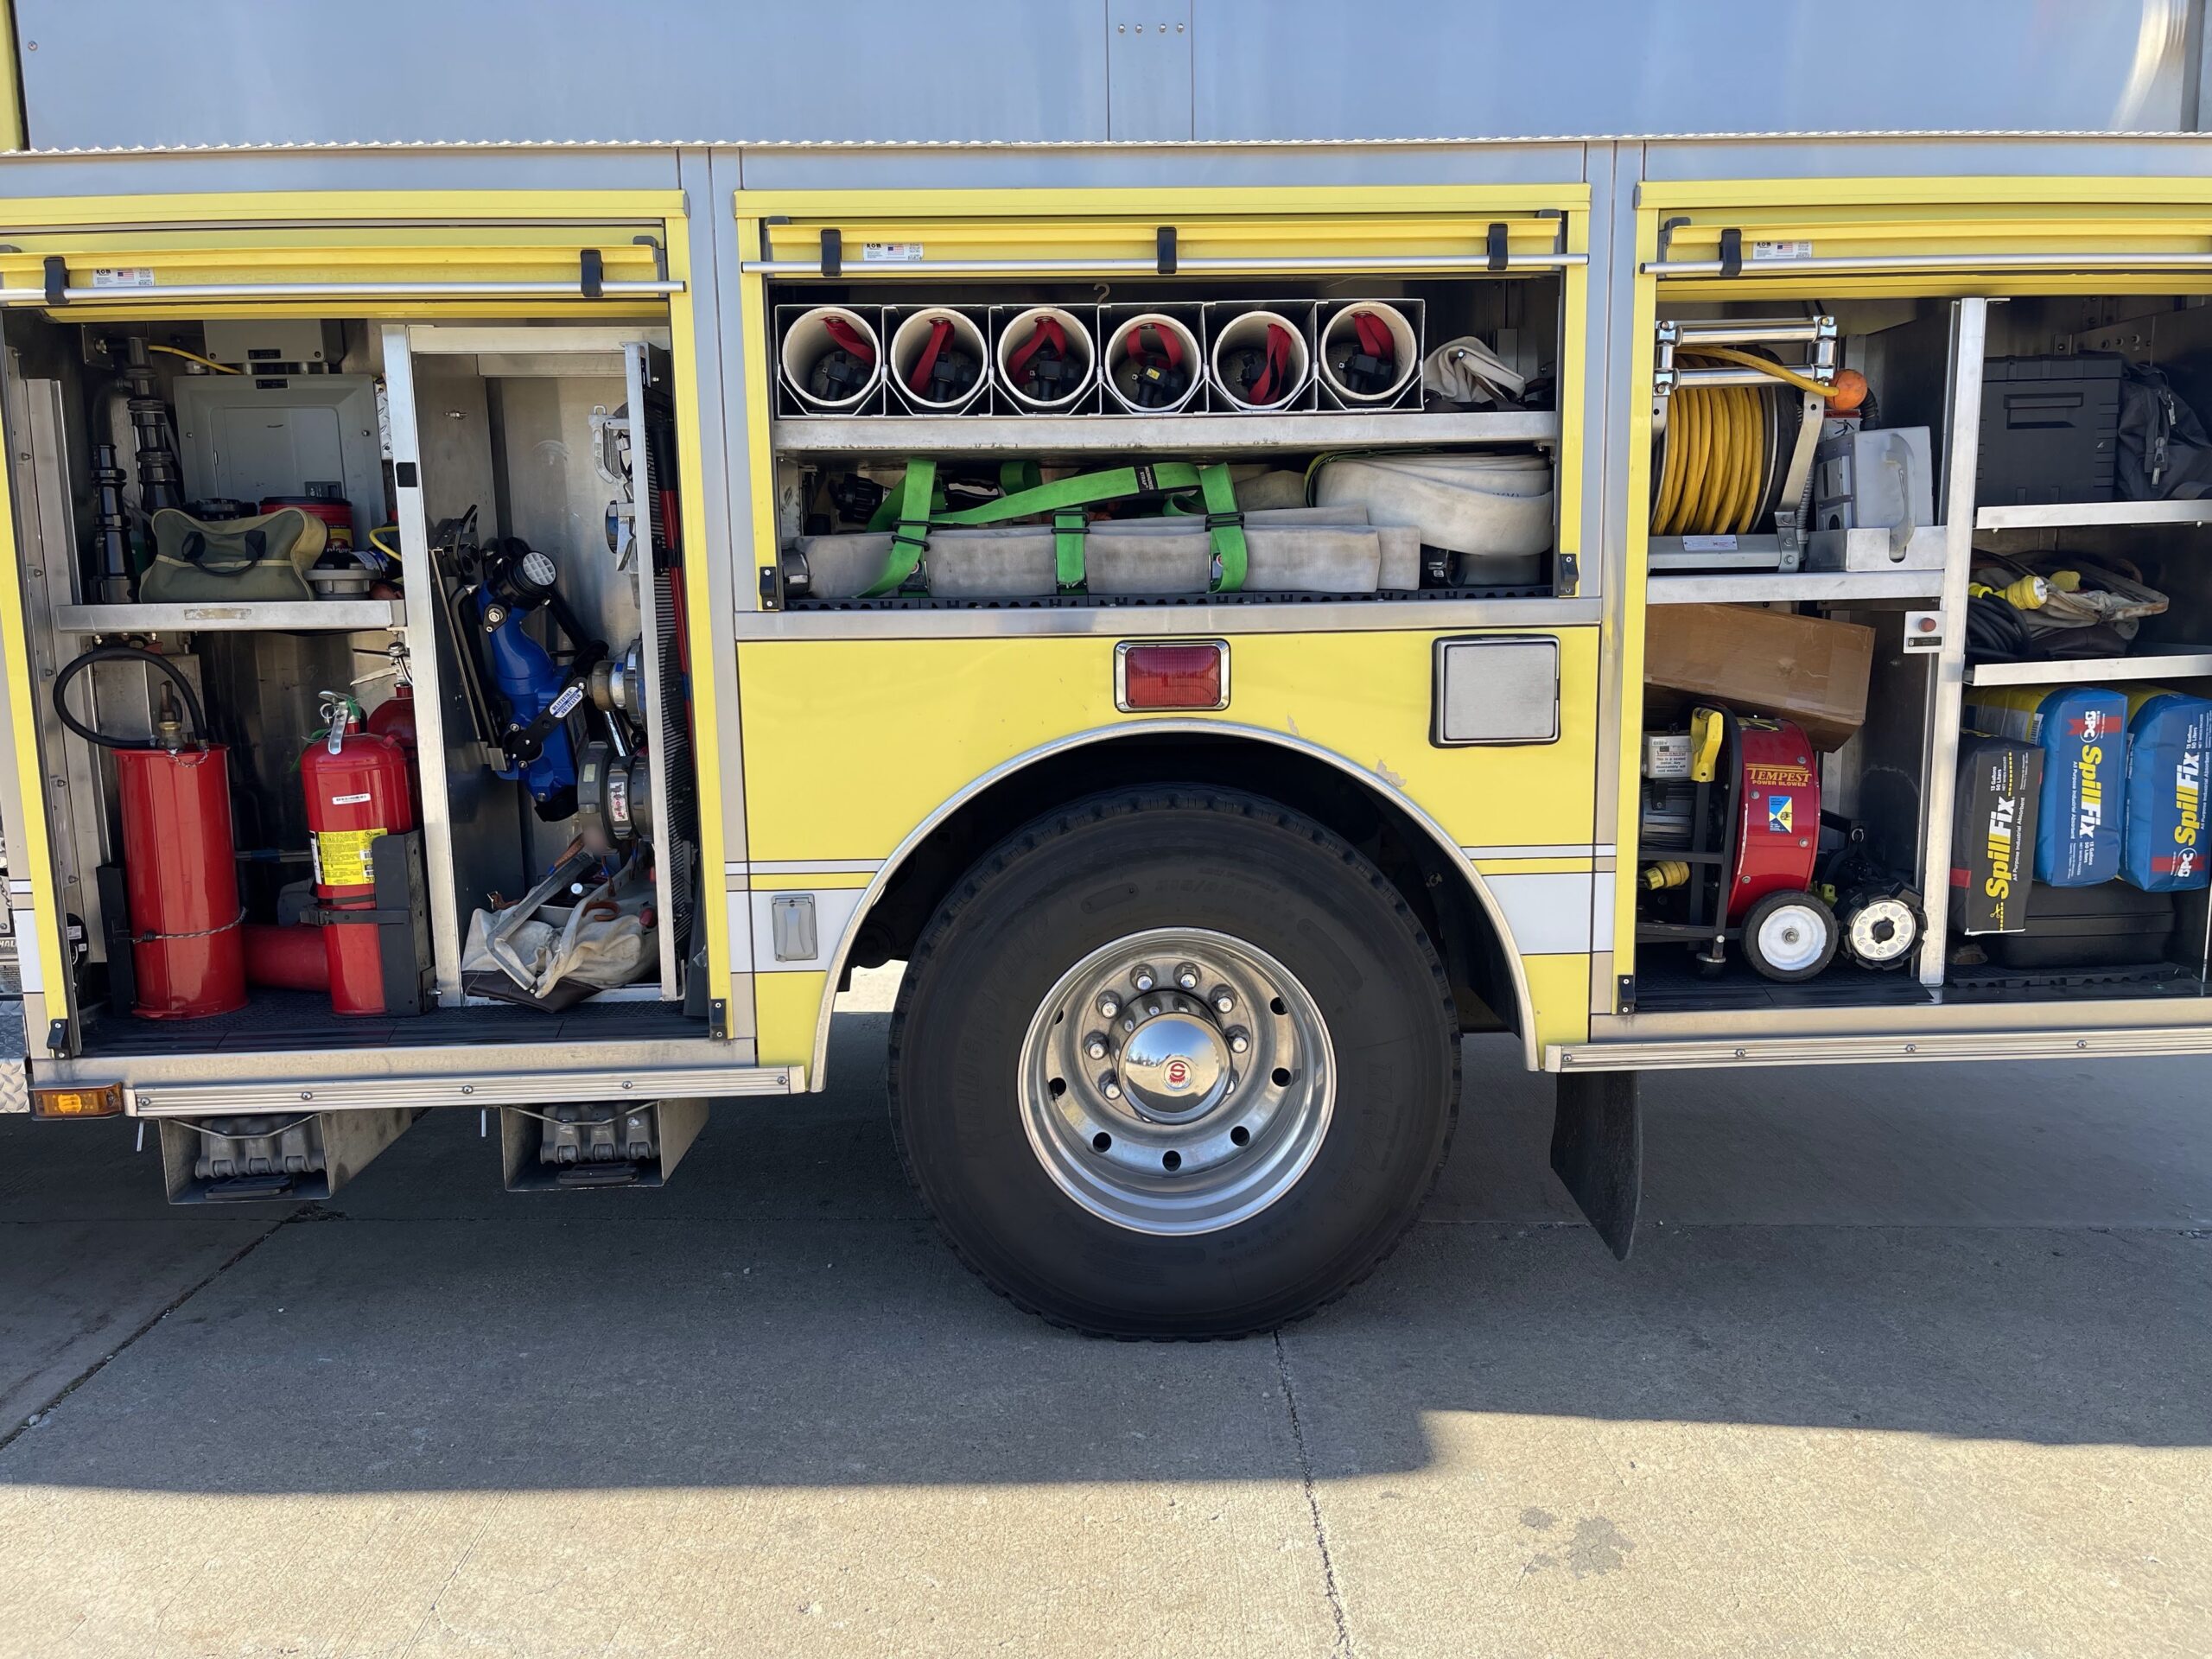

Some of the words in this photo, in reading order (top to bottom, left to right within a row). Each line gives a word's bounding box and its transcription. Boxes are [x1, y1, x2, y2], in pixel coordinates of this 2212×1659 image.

[1746, 767, 1812, 783] TEMPEST
[2079, 745, 2102, 838] SpillFix
[2174, 752, 2199, 846] SpillFix
[1986, 797, 2015, 899] SpillFix
[0, 939, 17, 948] HAL
